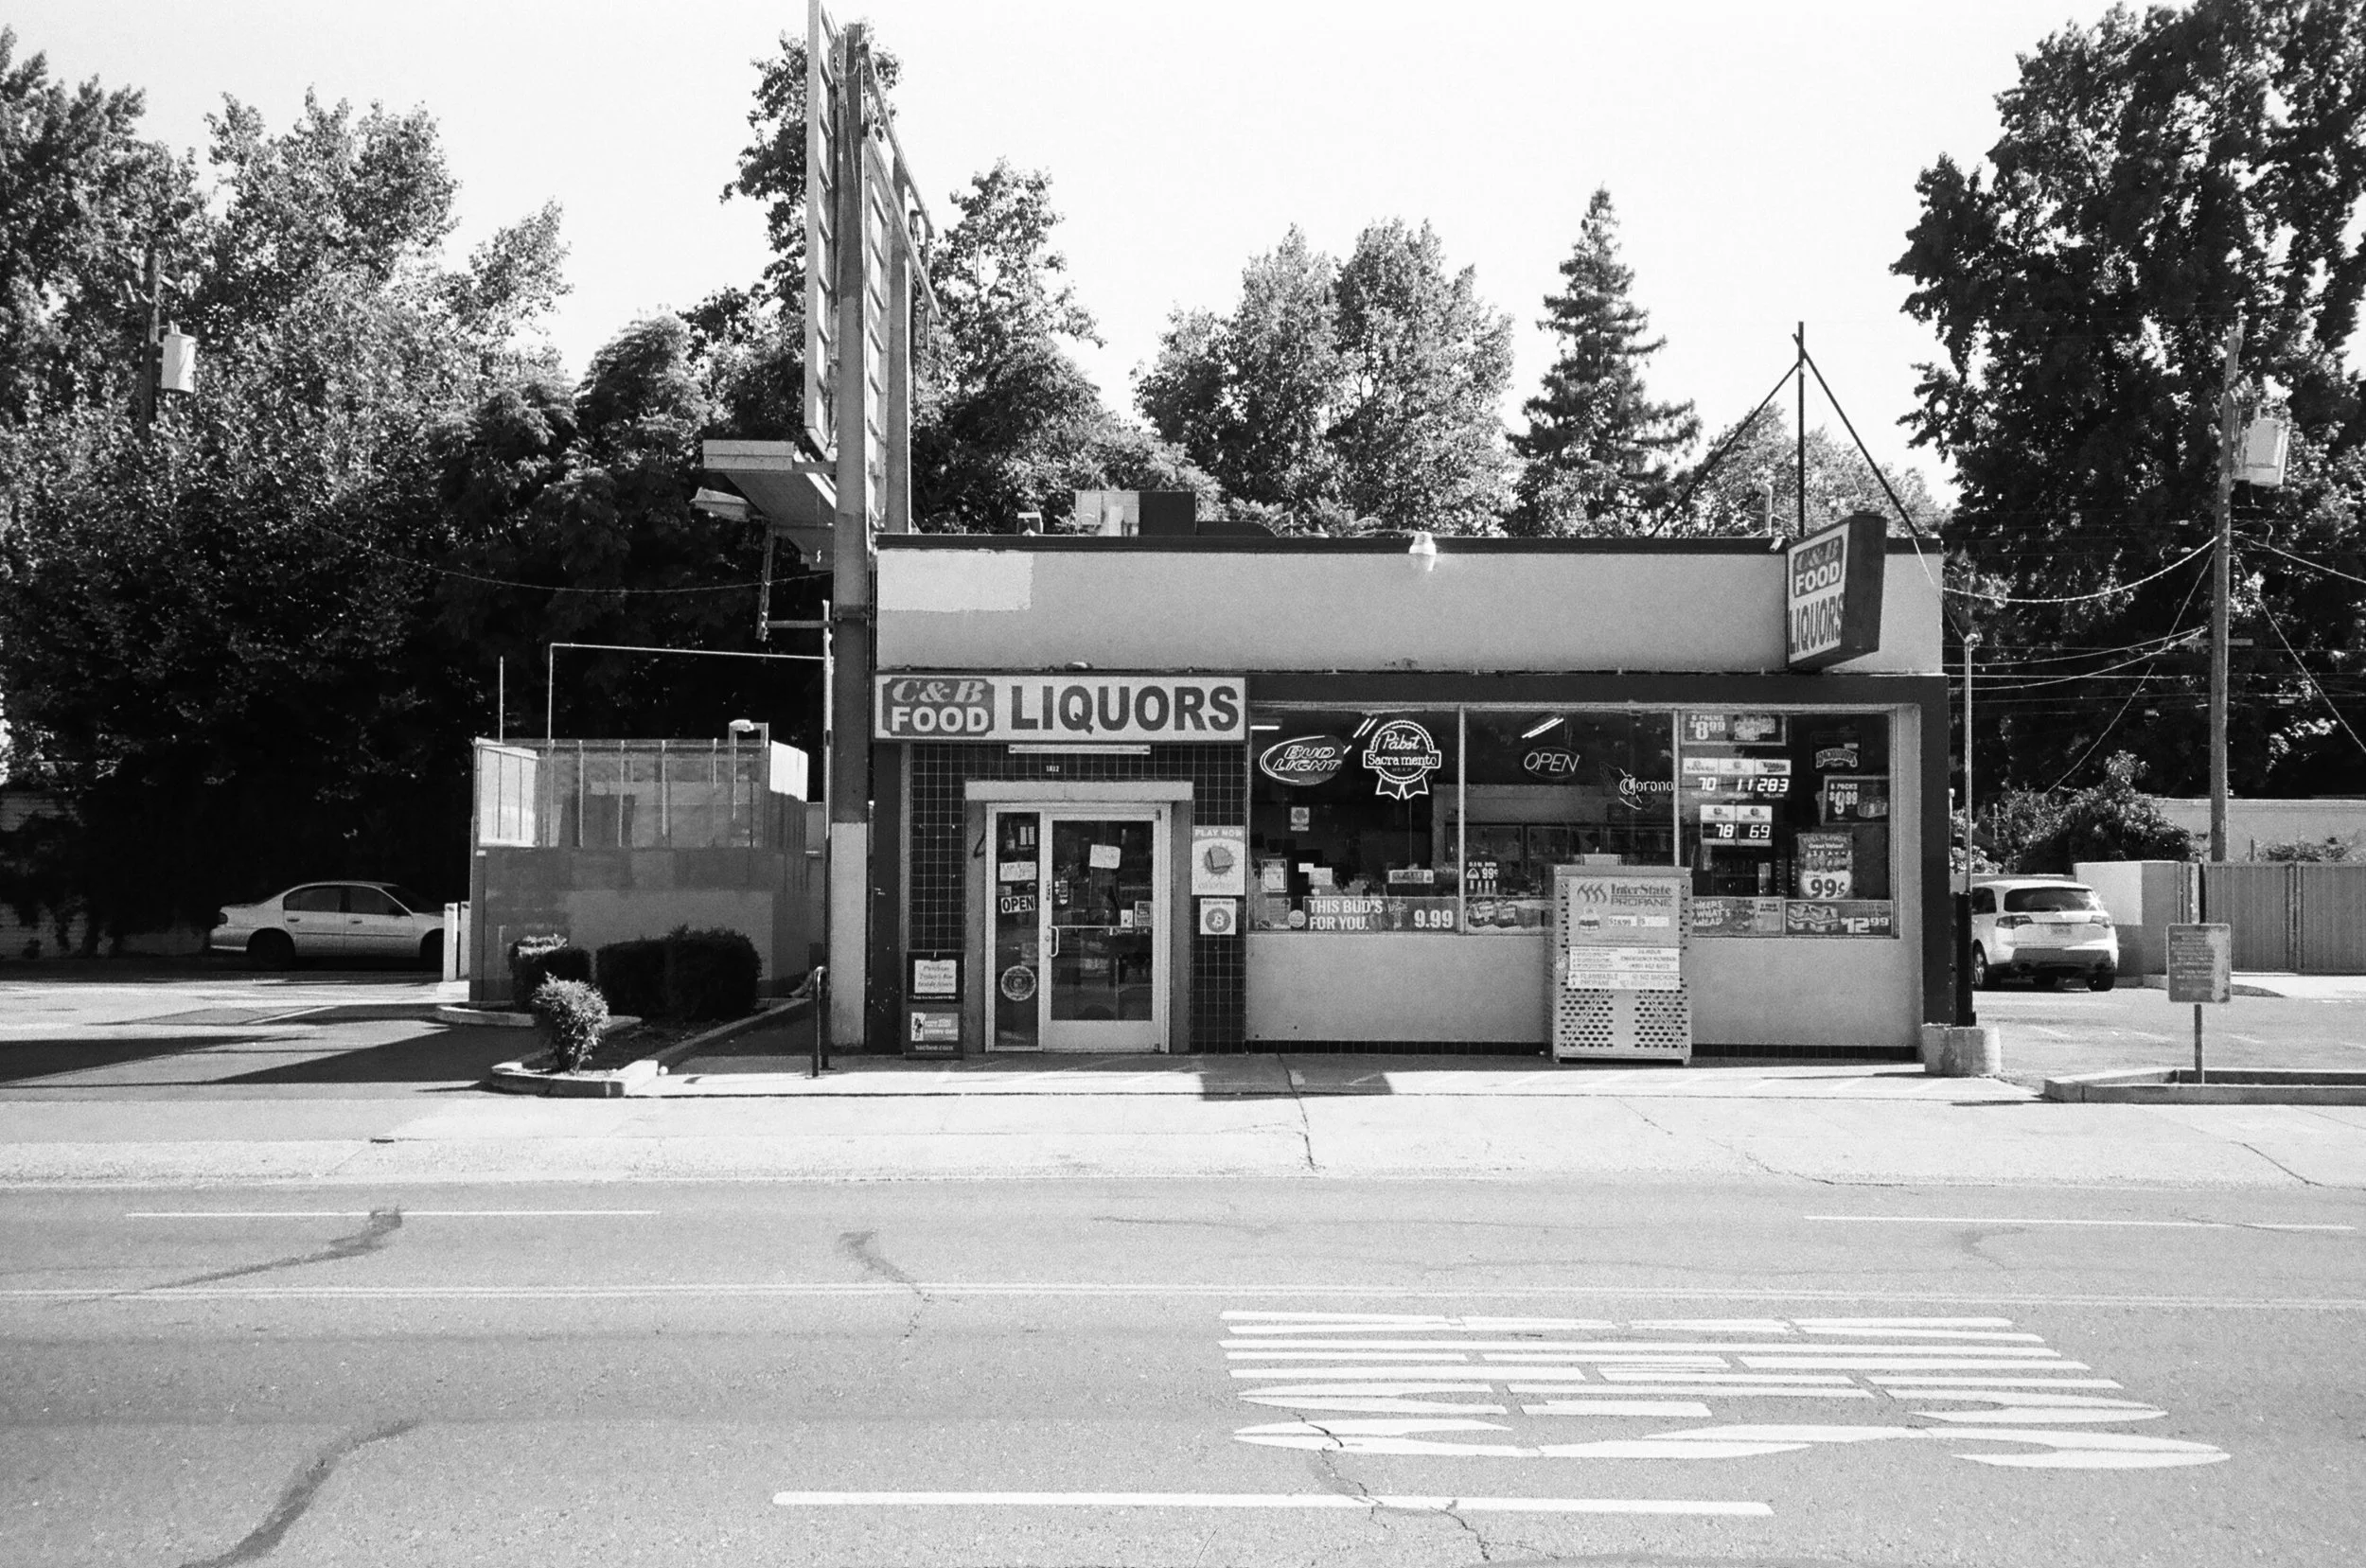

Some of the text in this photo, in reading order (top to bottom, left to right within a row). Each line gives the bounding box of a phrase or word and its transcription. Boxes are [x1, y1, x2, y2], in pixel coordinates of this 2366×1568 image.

[1795, 560, 1840, 595] FOOD
[1790, 592, 1845, 655] LIQUORS
[892, 679, 985, 703] C&B
[1011, 685, 1240, 734] LIQUORS
[891, 706, 989, 731] FOOD
[1382, 731, 1421, 750] Pabst
[1284, 745, 1335, 759] BUD
[1273, 759, 1342, 771] LIGHT
[1524, 752, 1580, 772] OPEN
[1619, 777, 1673, 795] Corona
[1699, 777, 1717, 791] 70
[1757, 778, 1789, 792] 283
[1194, 828, 1243, 837] PLAY NOW
[1716, 824, 1734, 837] 78
[1749, 824, 1771, 838] 69
[1001, 895, 1034, 912] OPEN
[1309, 899, 1339, 914] THIS
[1343, 899, 1384, 914] BUD'S
[1611, 898, 1672, 907] PROPANE
[1309, 916, 1369, 930] FOR YOU.
[1414, 909, 1454, 928] 9.99
